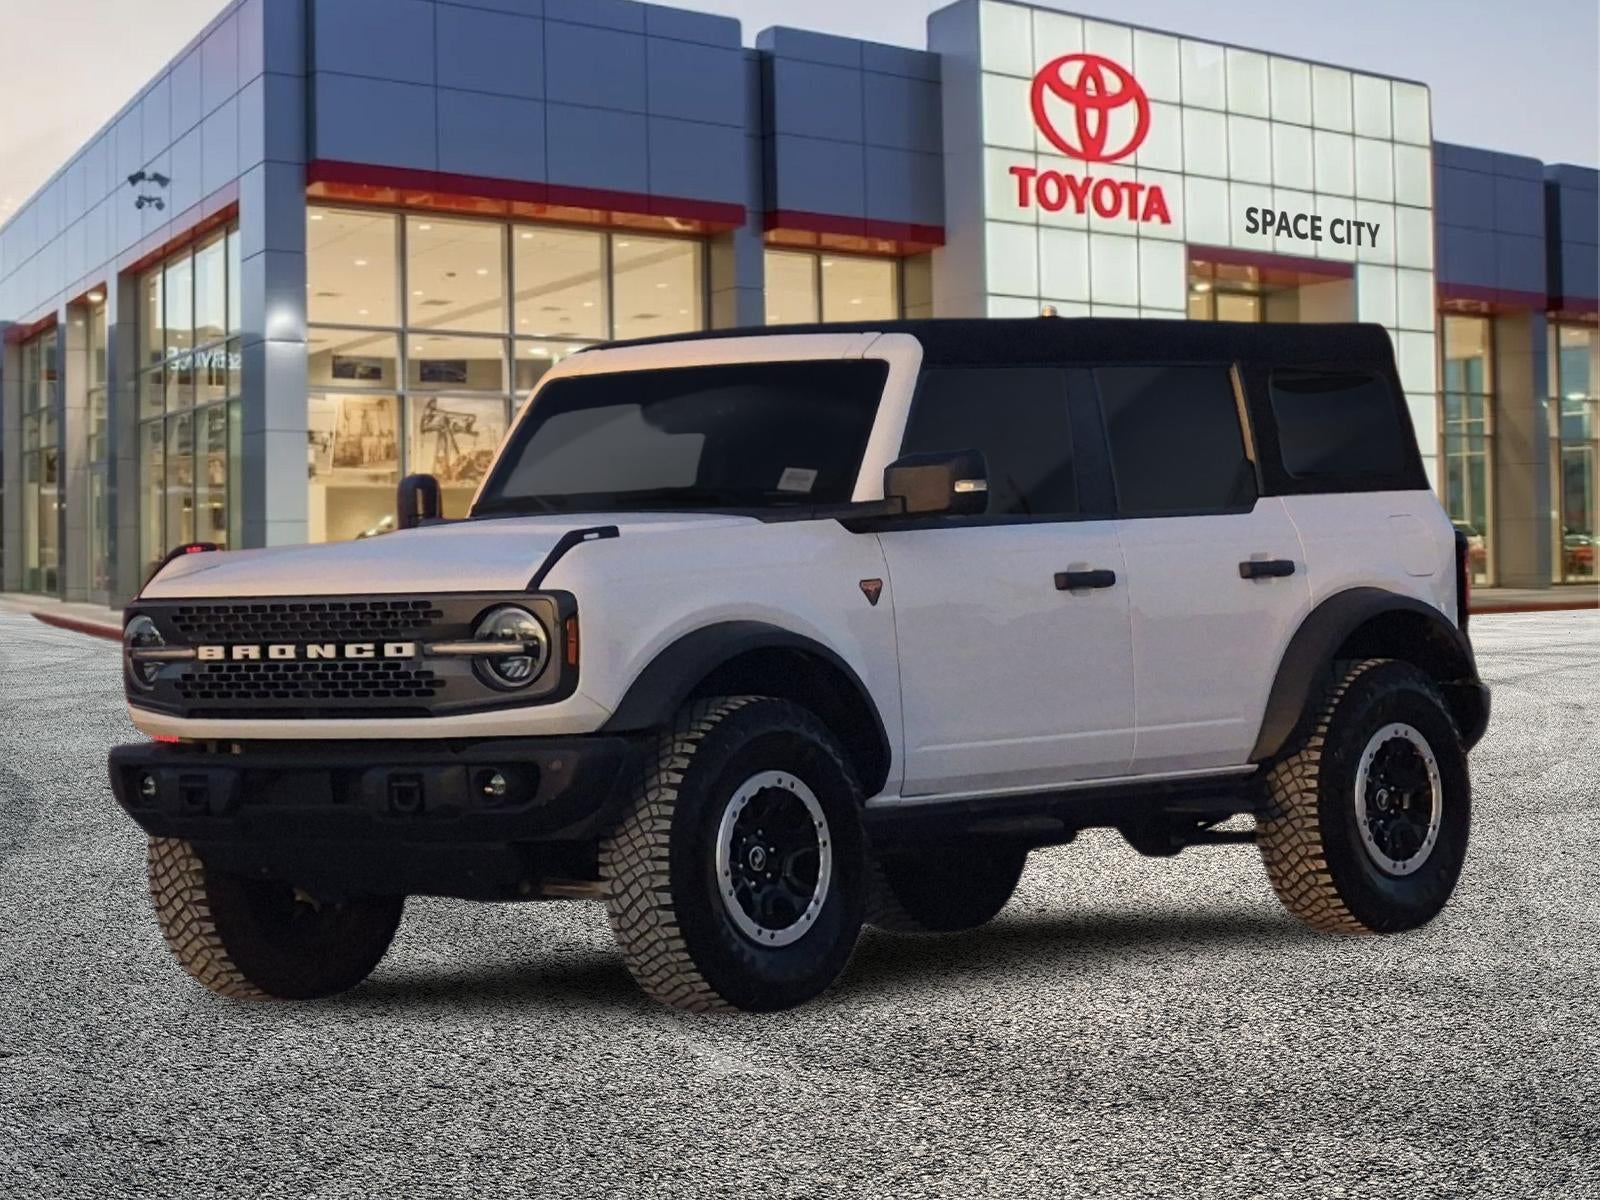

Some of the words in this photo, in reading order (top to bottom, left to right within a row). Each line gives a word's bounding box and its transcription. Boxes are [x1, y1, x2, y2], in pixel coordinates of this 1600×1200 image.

[1009, 166, 1171, 224] TOYOTA
[1245, 206, 1323, 241] SPACE
[1329, 218, 1381, 248] CITY
[198, 642, 416, 660] BRONCO
